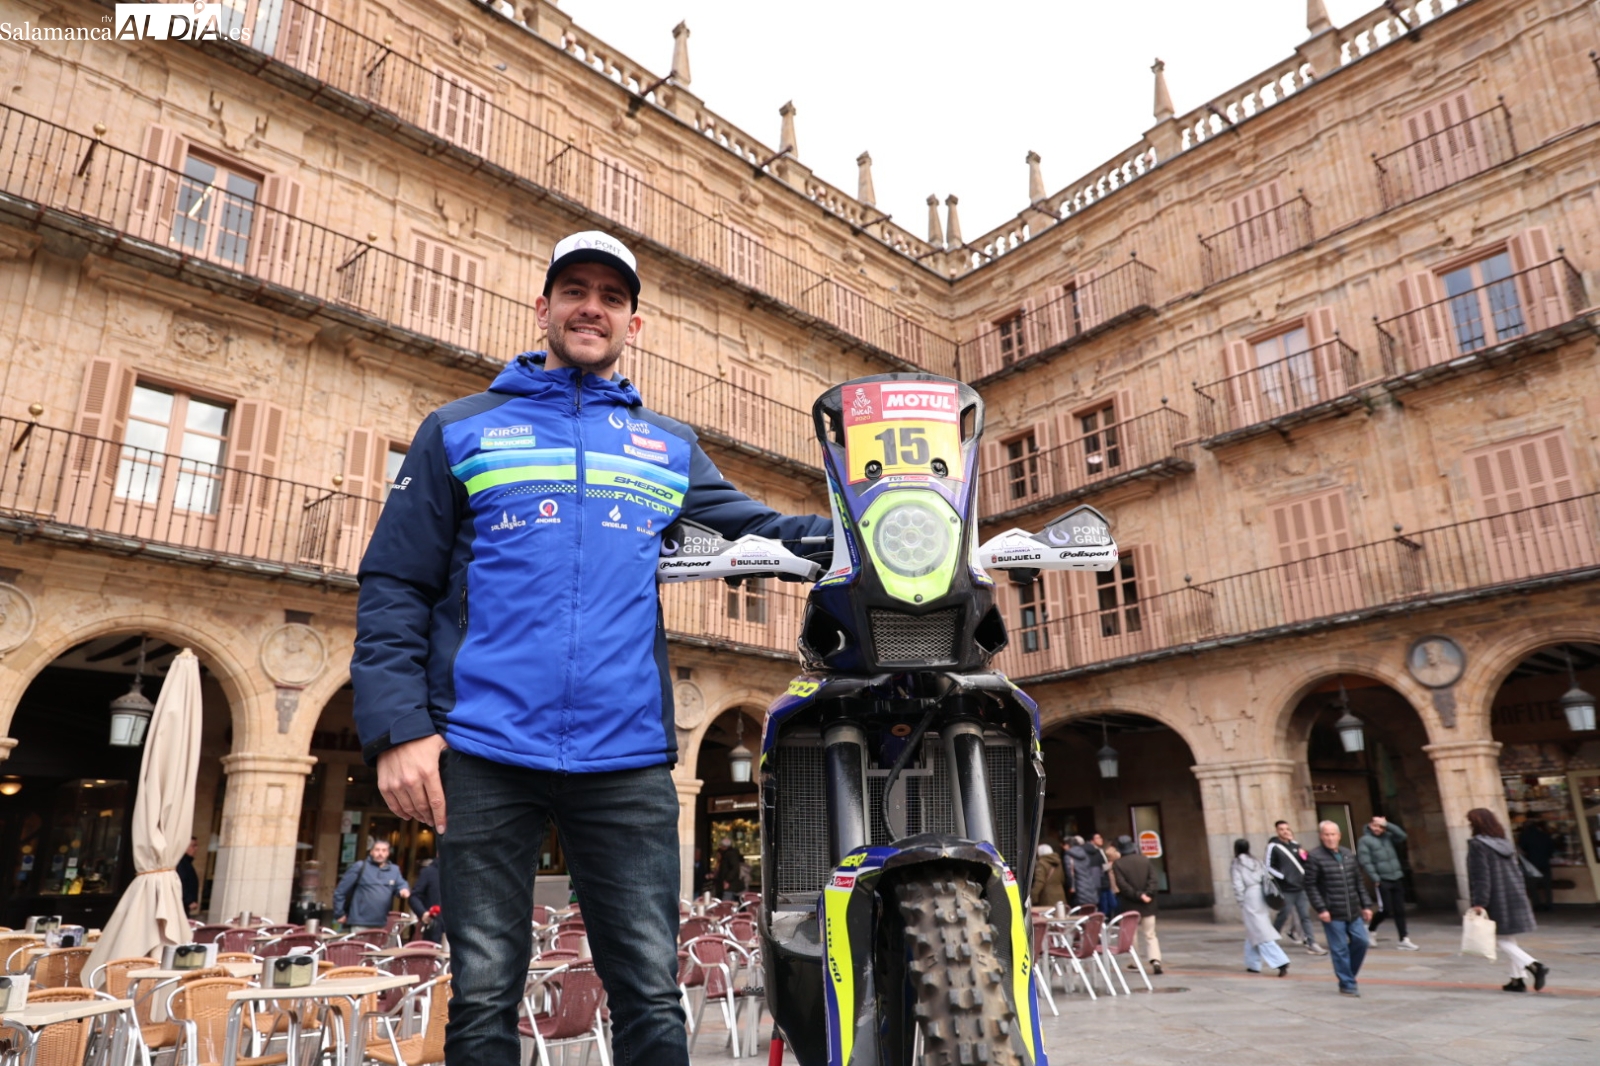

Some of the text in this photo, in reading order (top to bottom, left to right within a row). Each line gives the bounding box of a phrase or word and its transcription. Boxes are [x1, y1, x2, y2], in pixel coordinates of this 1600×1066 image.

[595, 240, 621, 255] PONT
[887, 394, 952, 409] MOTUL
[488, 426, 528, 437] AIROH
[494, 439, 533, 447] MOTOREX
[875, 427, 930, 466] 15
[614, 476, 674, 500] SHERCO
[614, 491, 675, 517] FACTORY
[601, 521, 628, 530] CANDELAS
[1073, 526, 1107, 536] PONT
[684, 536, 720, 546] PONT
[1075, 535, 1109, 544] GRUP
[682, 545, 720, 554] GRUP
[998, 554, 1041, 562] GUIJUELO
[1060, 551, 1109, 559] Polisport
[660, 561, 711, 570] Polisport
